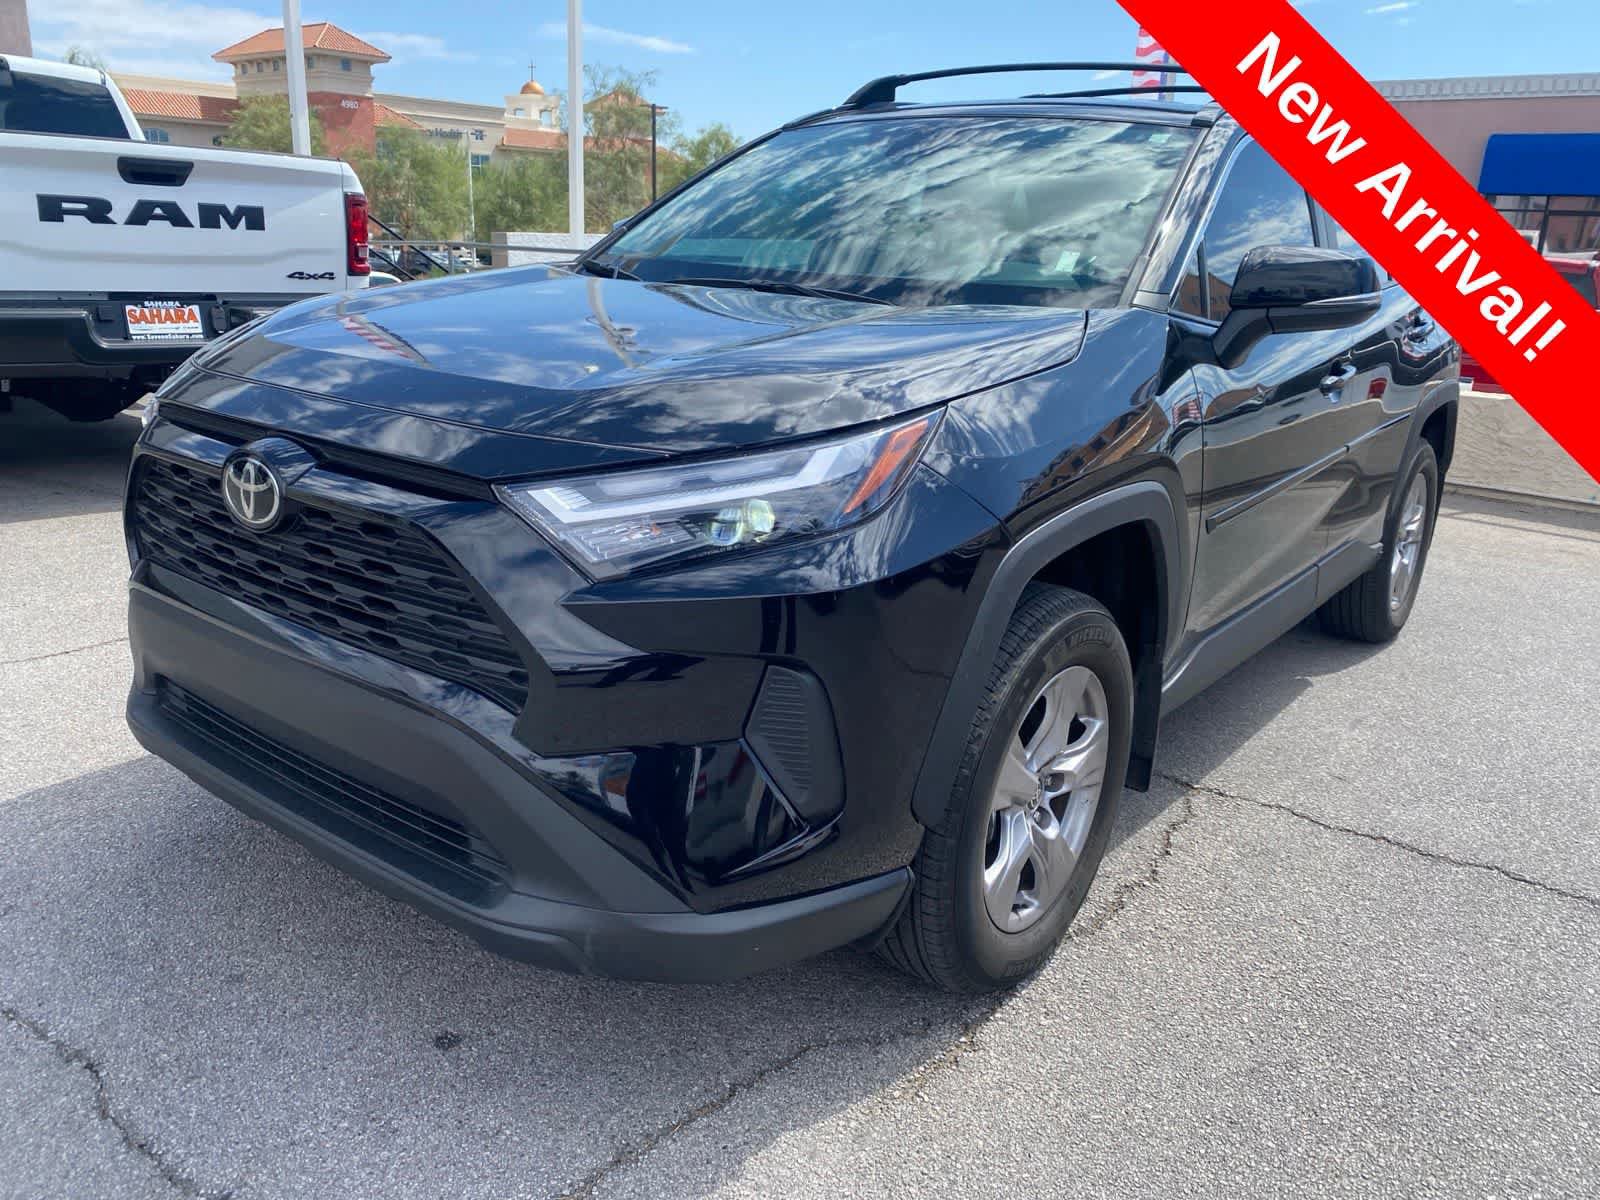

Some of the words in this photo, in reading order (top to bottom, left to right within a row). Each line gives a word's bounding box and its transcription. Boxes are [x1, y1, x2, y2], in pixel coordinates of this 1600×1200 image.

[36, 193, 266, 231] RAM
[285, 271, 336, 281] 4x4
[127, 308, 199, 324] SAHARA
